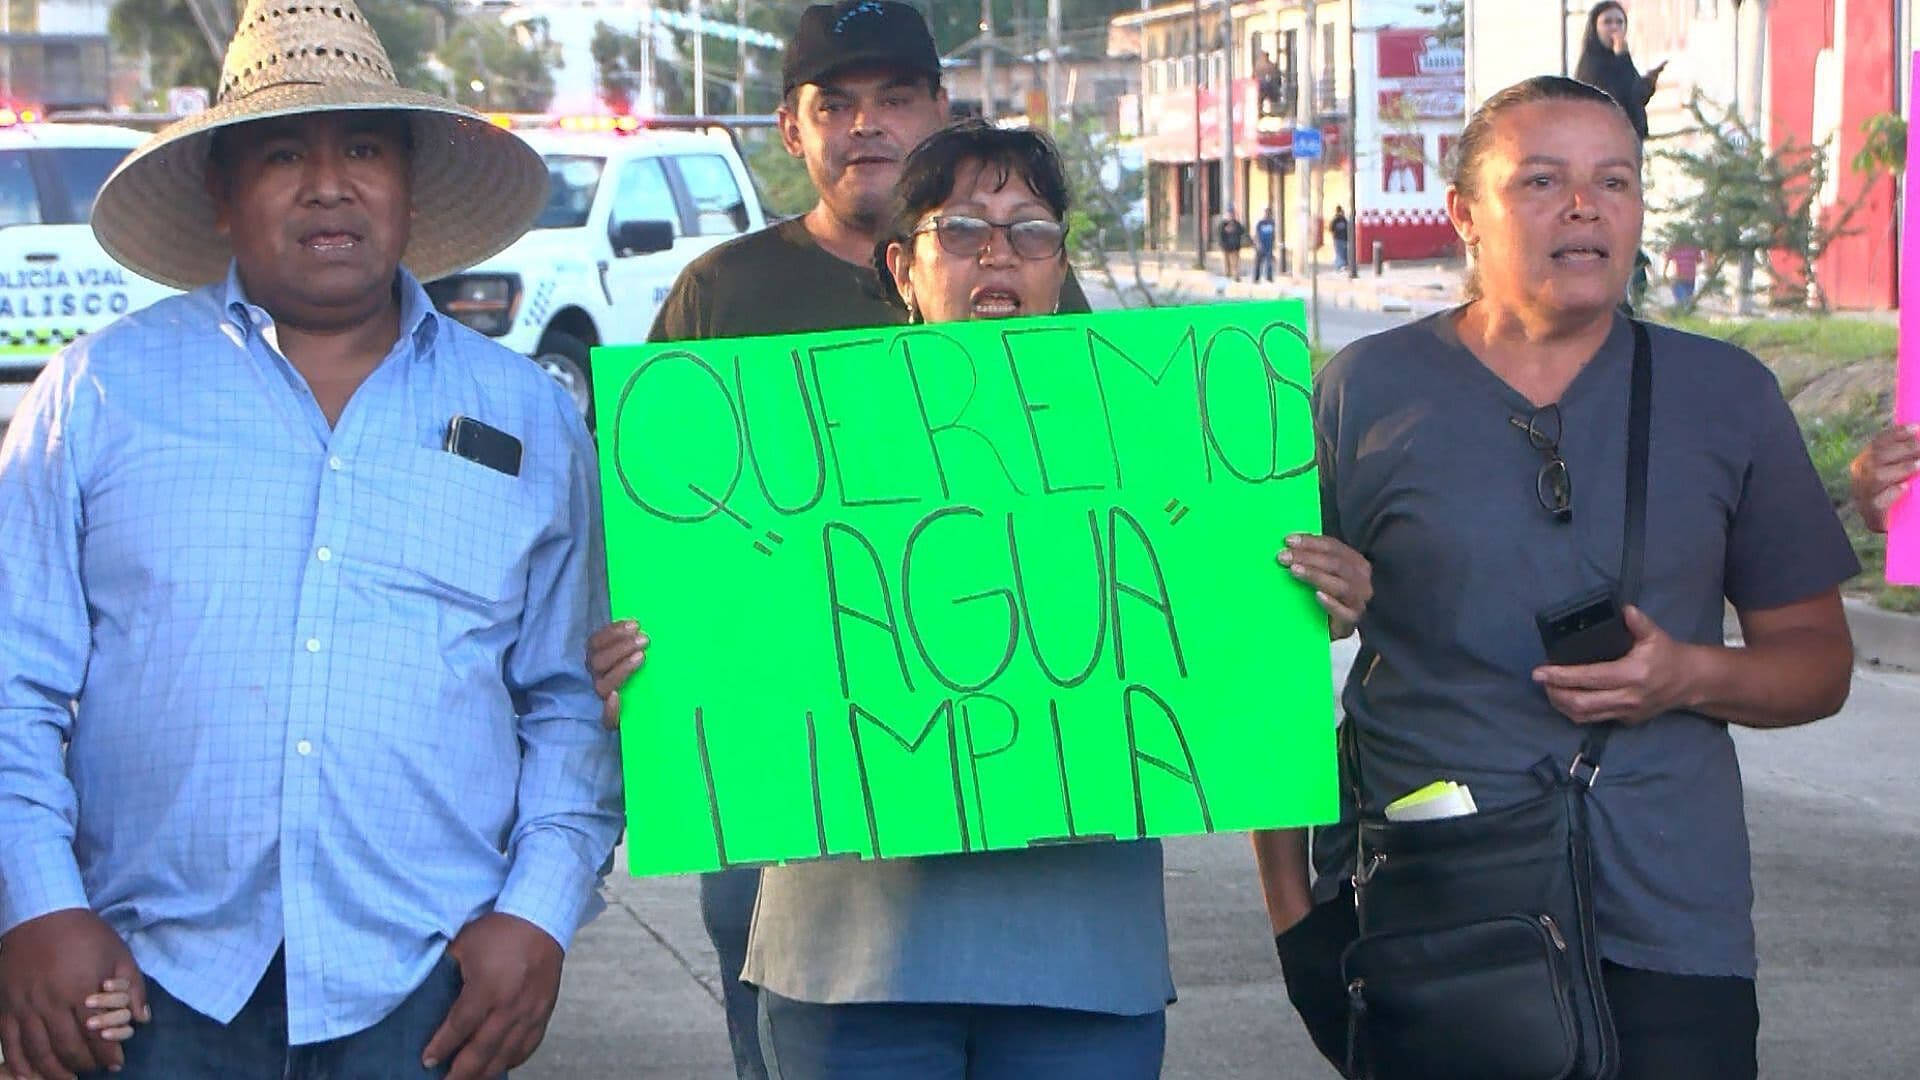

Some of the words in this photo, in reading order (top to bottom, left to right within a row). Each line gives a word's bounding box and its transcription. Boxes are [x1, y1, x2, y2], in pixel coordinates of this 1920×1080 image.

[76, 268, 128, 286] VIAL
[614, 321, 1318, 530] QUEREMOS
[695, 686, 1214, 868] LIMPIA
